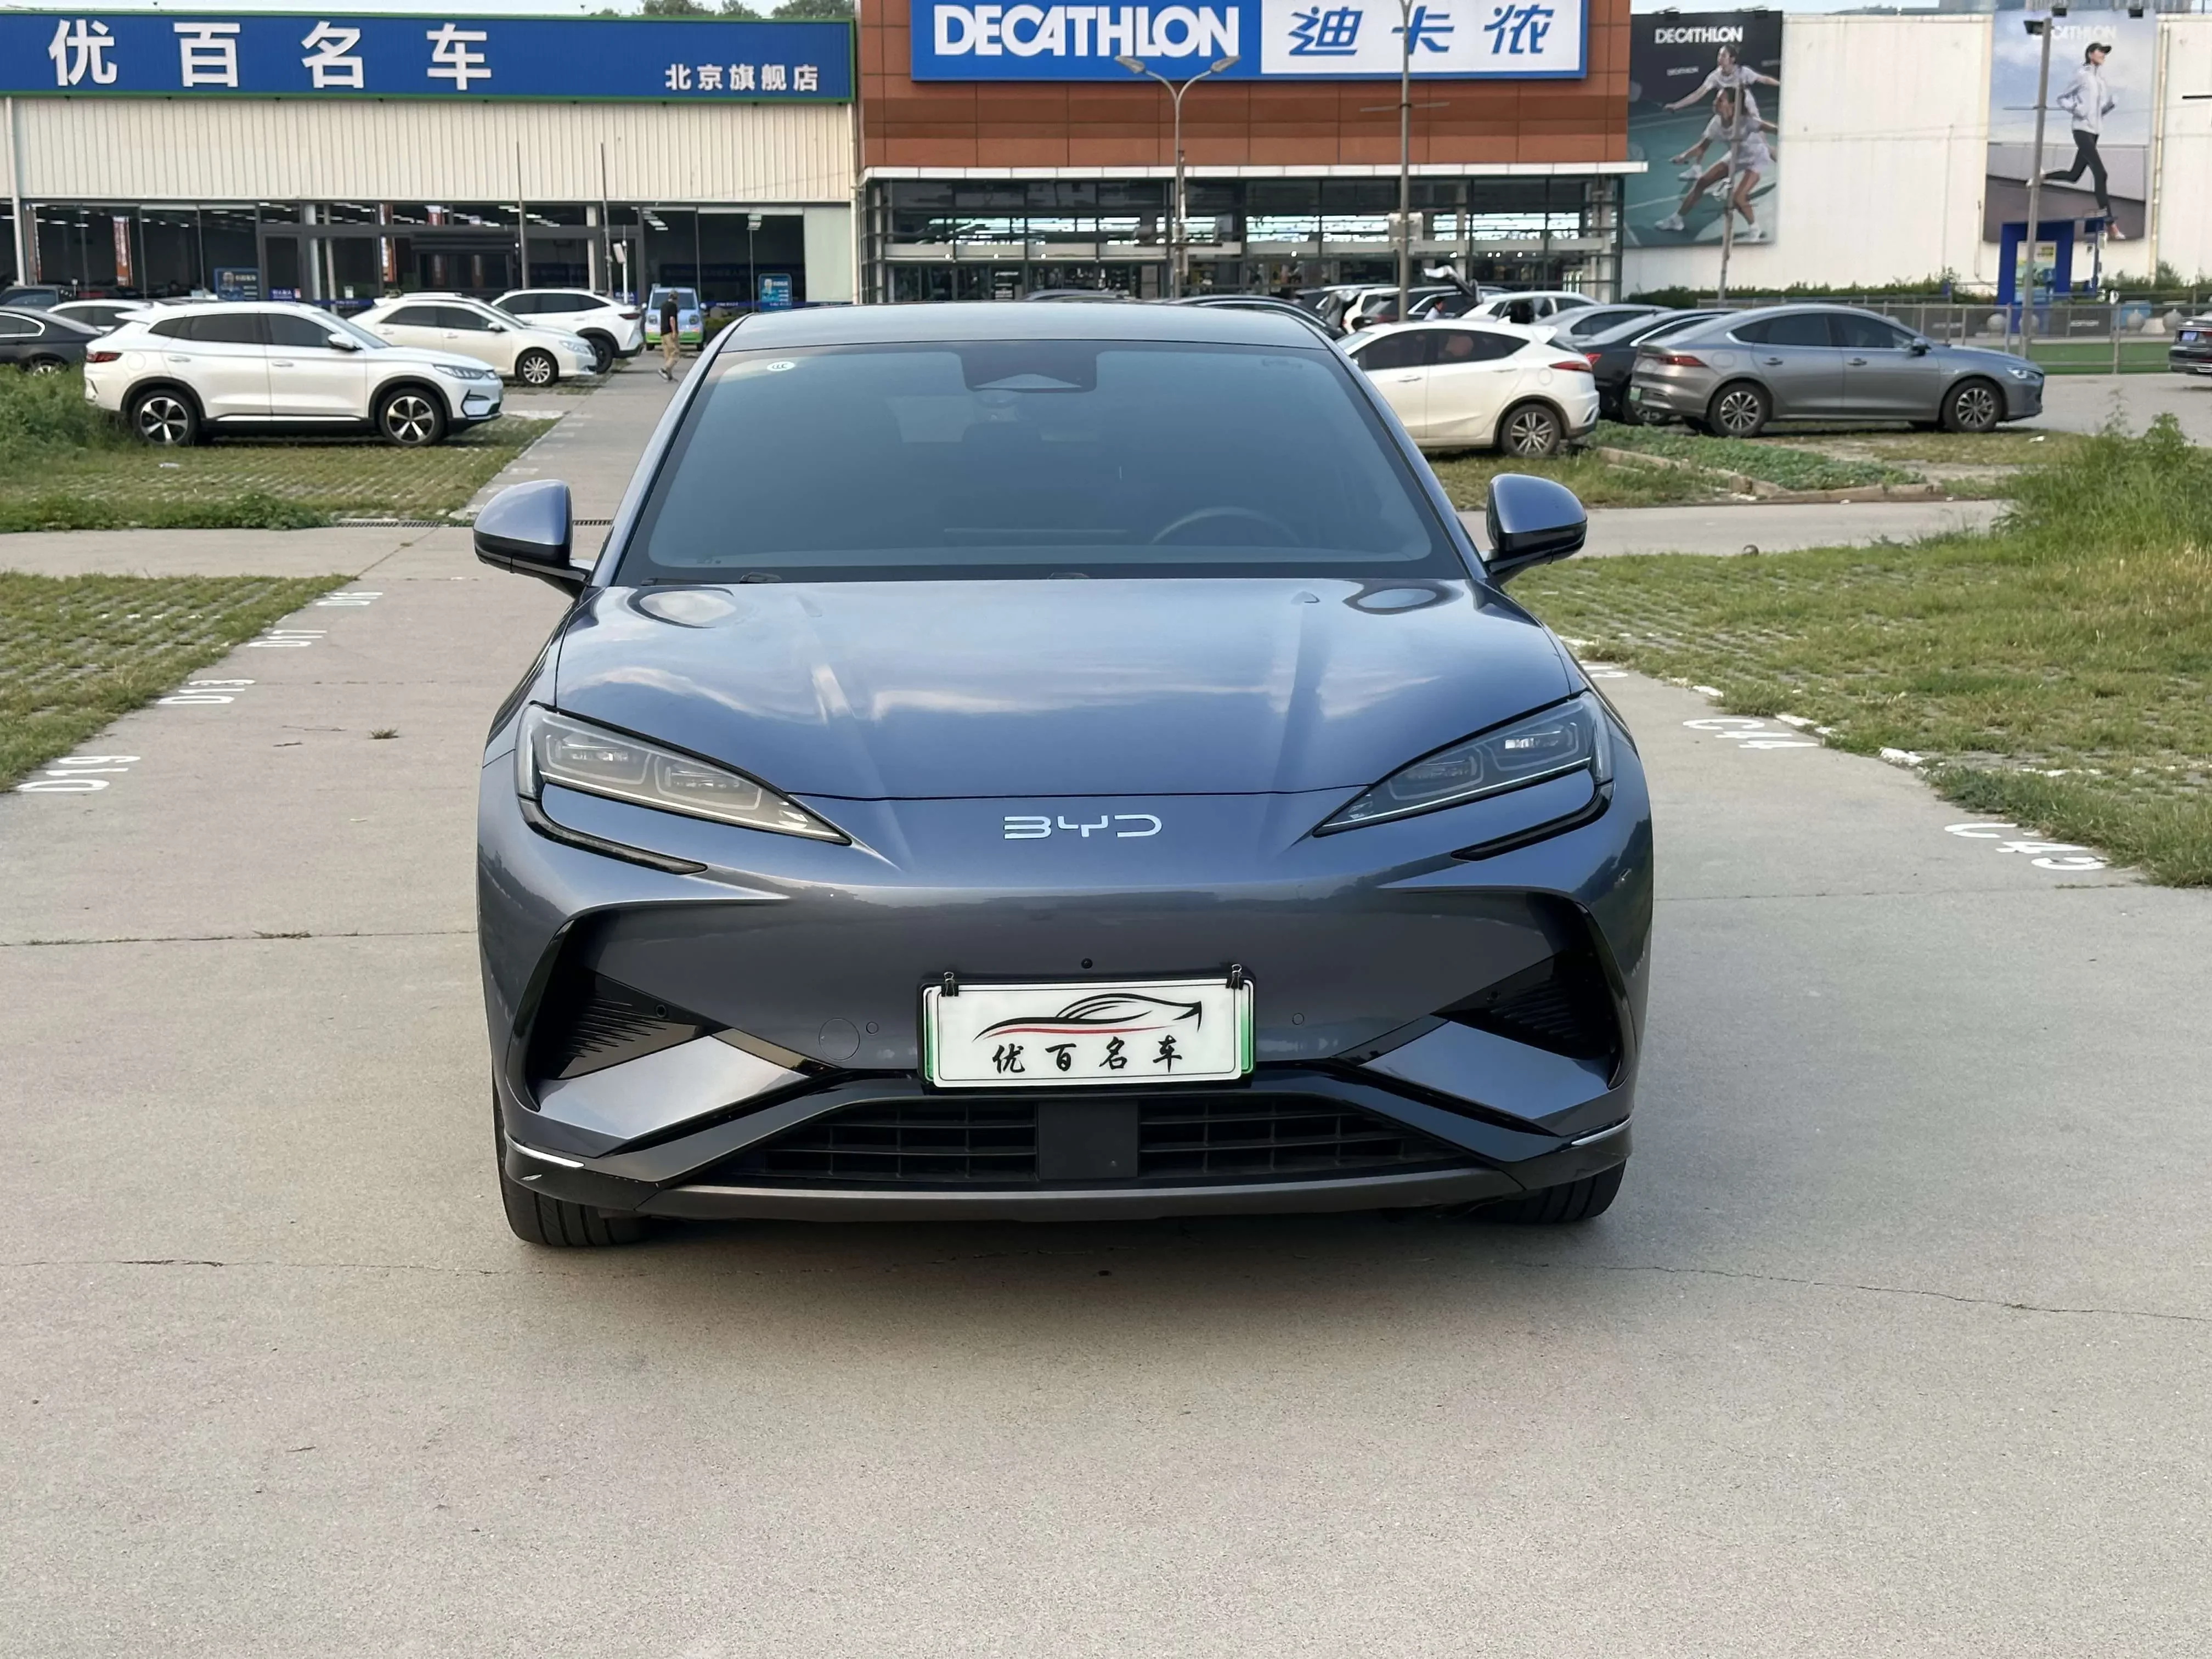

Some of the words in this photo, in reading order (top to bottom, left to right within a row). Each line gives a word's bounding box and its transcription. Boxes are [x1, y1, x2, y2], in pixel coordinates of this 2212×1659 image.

[934, 4, 1240, 57] DECATHLON
[1288, 4, 1555, 55] 迪卡侬
[1655, 26, 1743, 44] DECATHLON
[2032, 25, 2117, 40] CATHLON
[48, 19, 492, 90] 优百名车
[665, 64, 818, 91] 北京旗舰店
[16, 755, 140, 792] D19
[1003, 814, 1163, 839] BYD
[992, 1034, 1183, 1074] 优百名车
